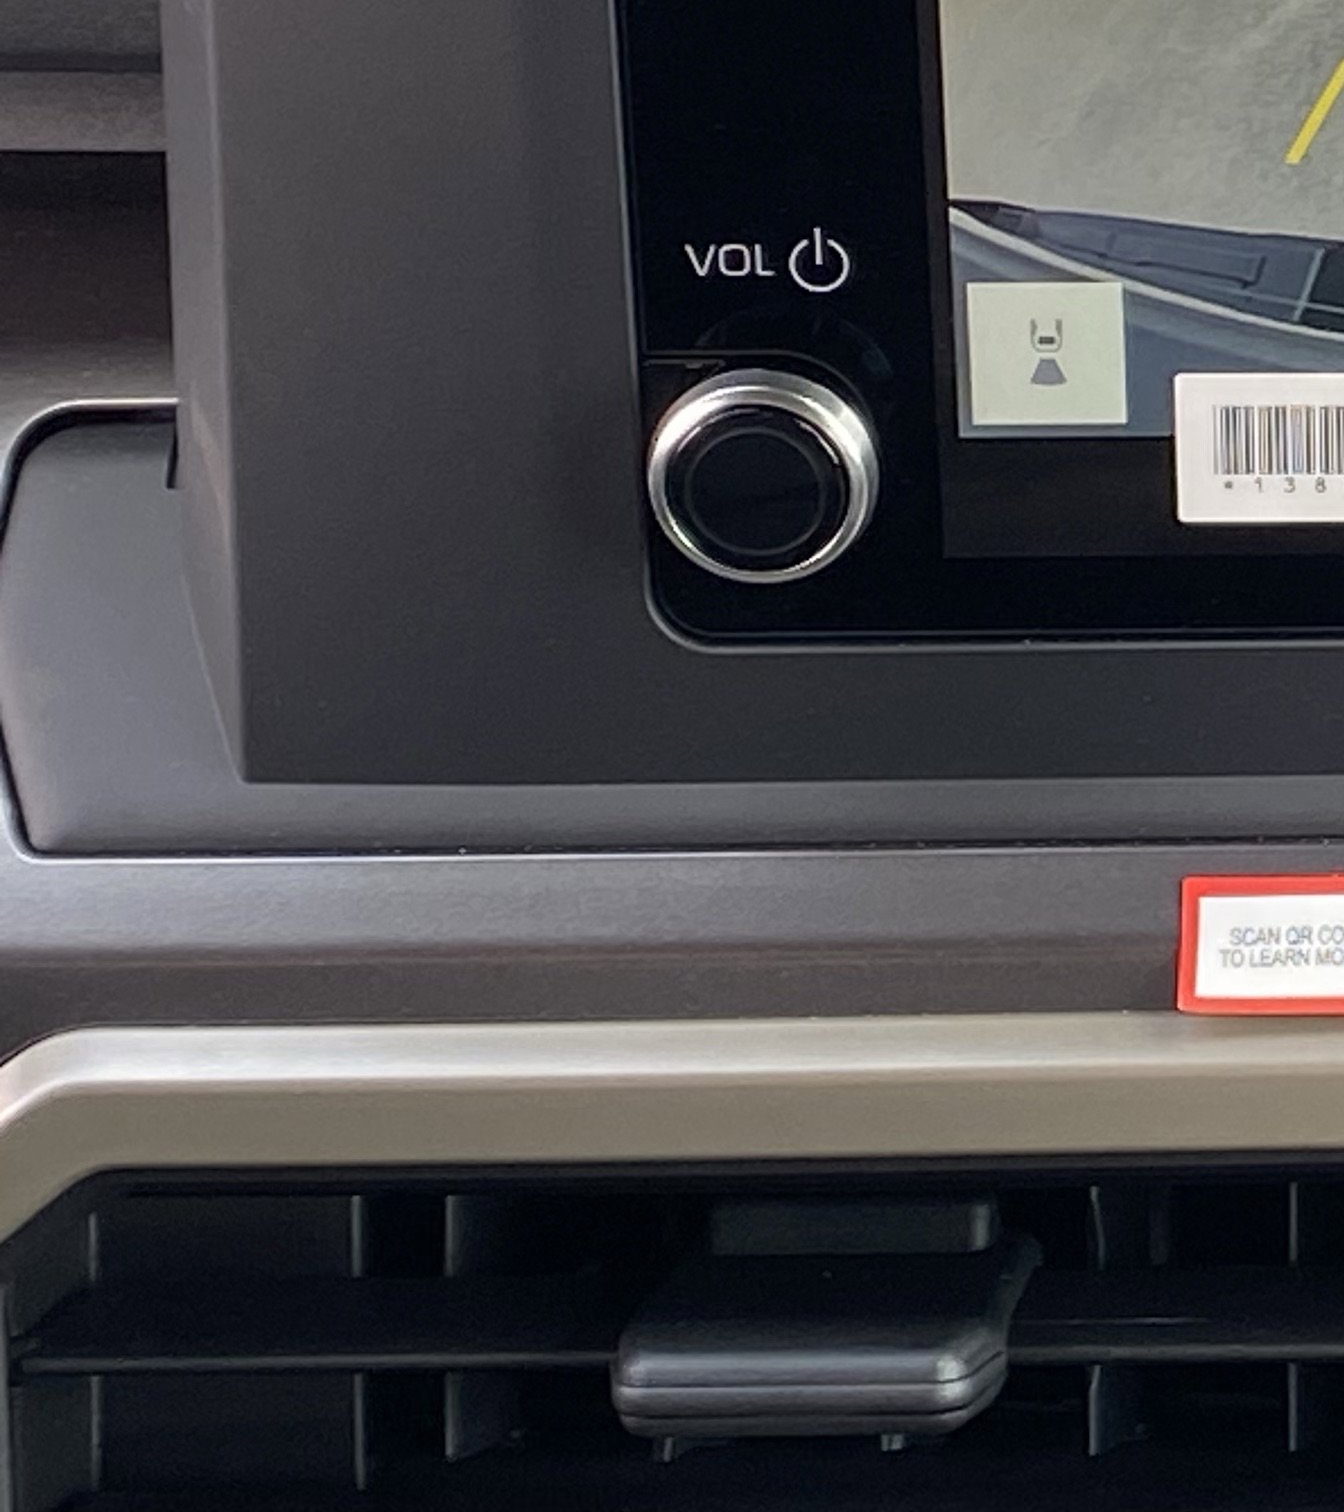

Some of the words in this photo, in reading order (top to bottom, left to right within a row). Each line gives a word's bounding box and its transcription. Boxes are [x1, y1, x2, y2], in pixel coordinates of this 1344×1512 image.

[684, 244, 775, 276] VOL
[1229, 926, 1281, 946] SCAN
[1285, 925, 1313, 945] QR
[1219, 949, 1245, 968] TO
[1250, 948, 1311, 968] LEARN
